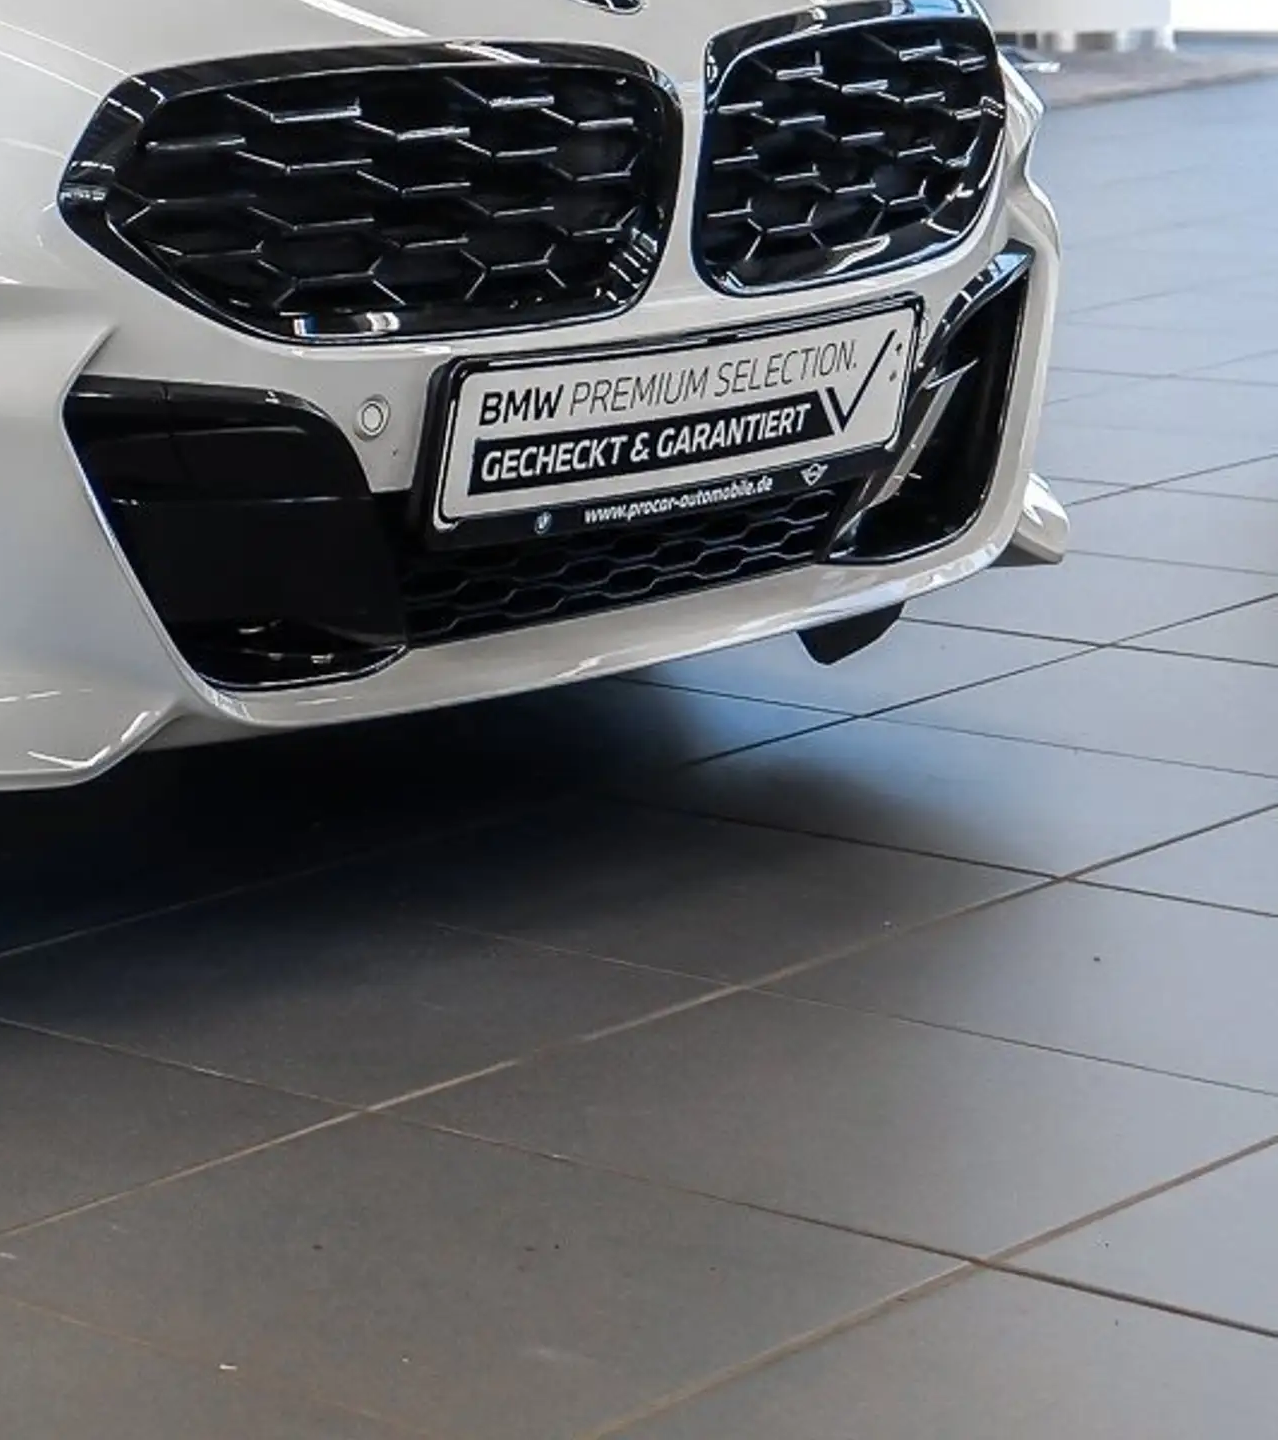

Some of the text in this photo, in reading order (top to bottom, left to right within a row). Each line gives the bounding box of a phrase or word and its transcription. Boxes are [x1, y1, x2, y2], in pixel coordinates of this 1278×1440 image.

[479, 339, 857, 426] BMW PREMIUM SELECTION.
[482, 403, 811, 482] GECHECKT & GARANTIERT
[584, 475, 773, 523] www.procar-automobile.de
